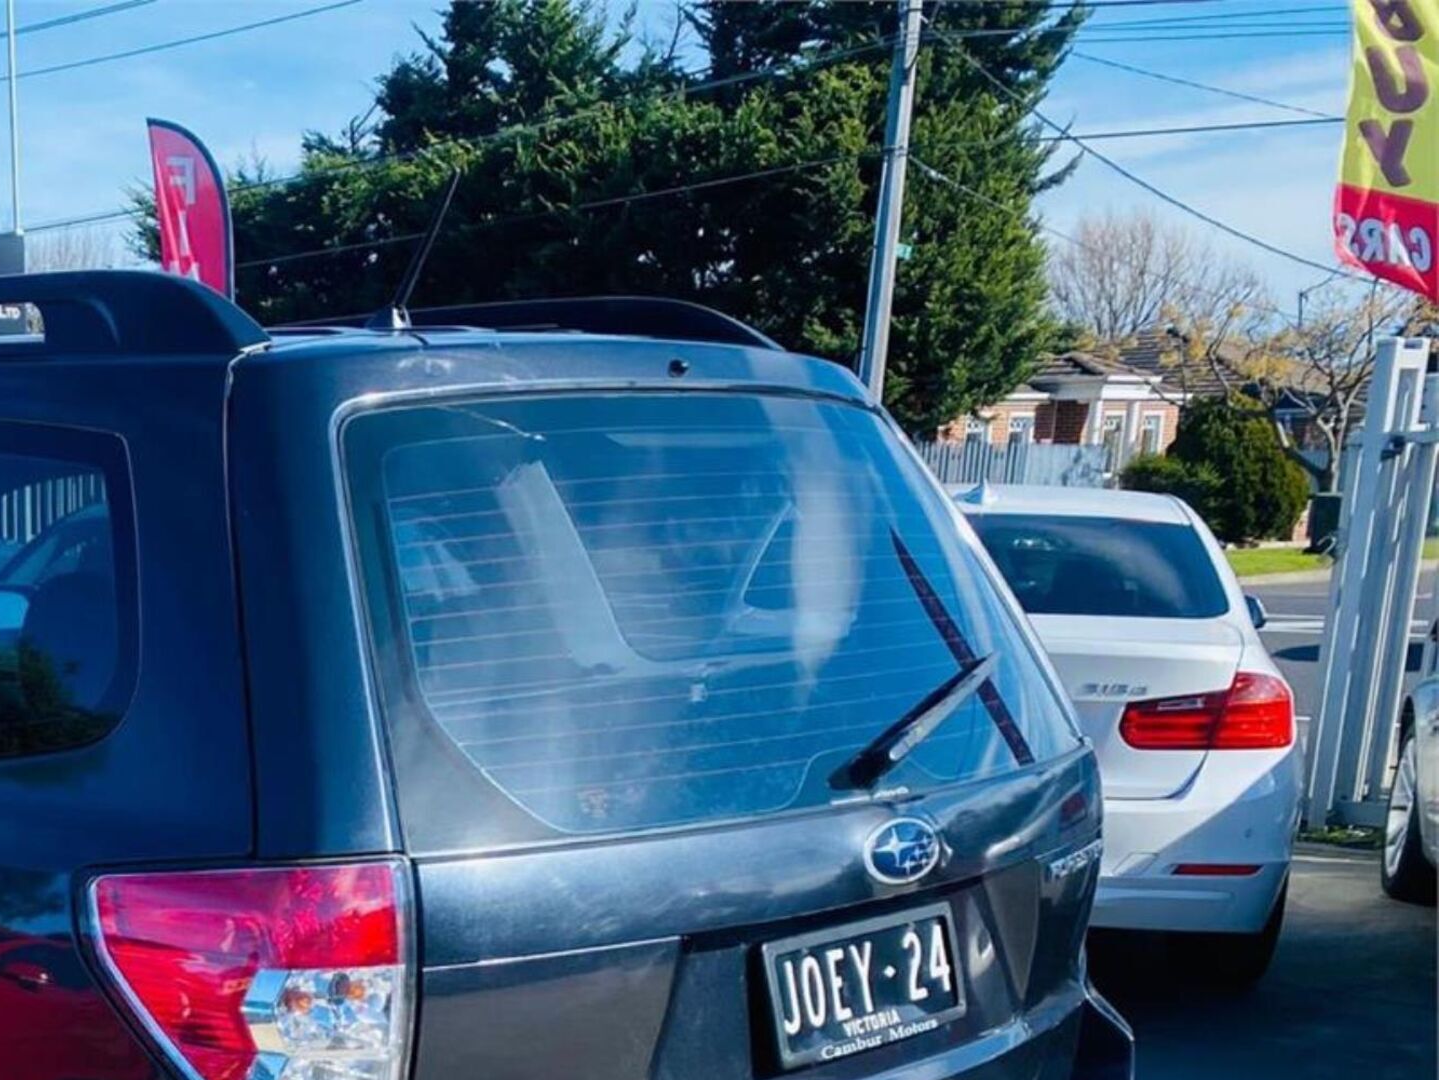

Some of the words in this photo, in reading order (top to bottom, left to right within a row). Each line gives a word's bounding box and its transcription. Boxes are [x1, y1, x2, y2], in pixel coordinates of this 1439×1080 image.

[821, 1035, 882, 1059] Cambur
[889, 1018, 939, 1042] Motors
[842, 1009, 901, 1037] VICTORIA
